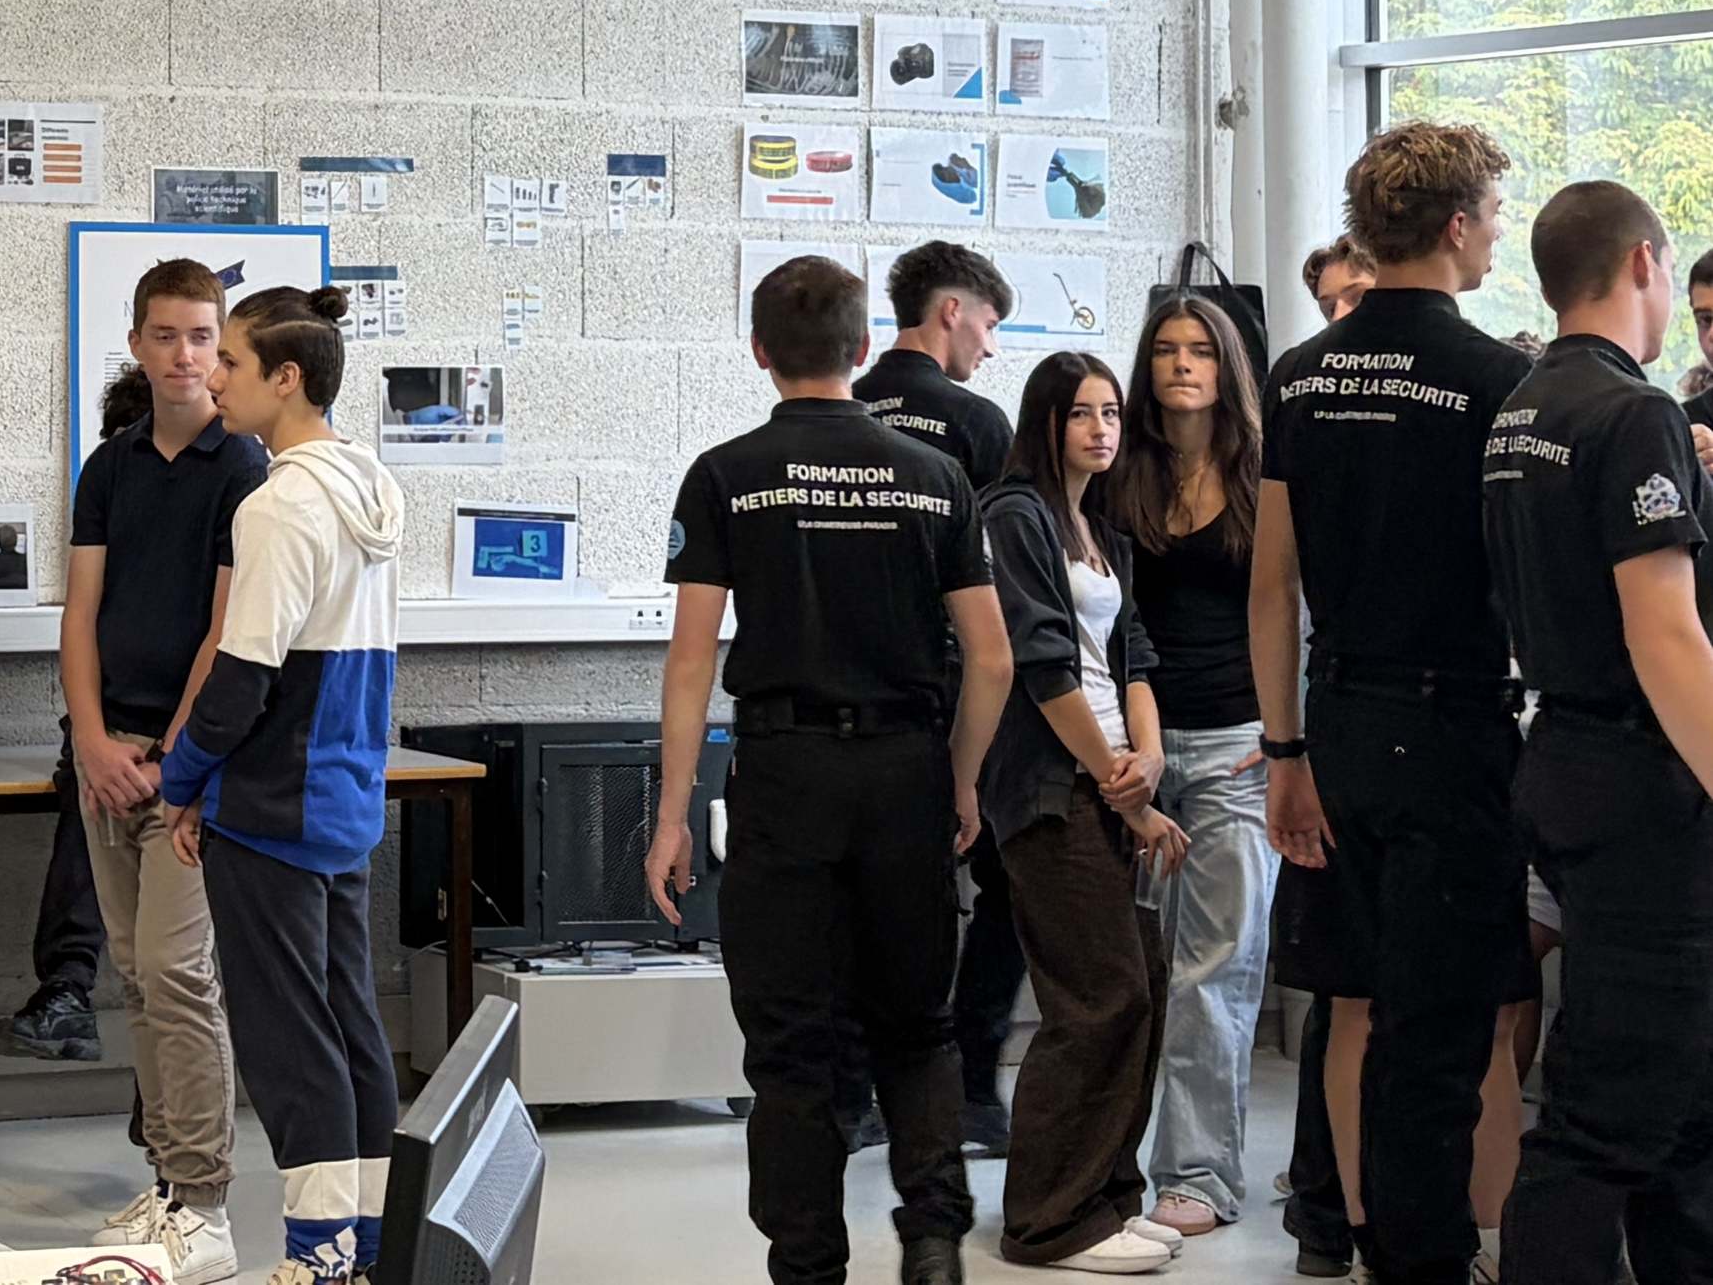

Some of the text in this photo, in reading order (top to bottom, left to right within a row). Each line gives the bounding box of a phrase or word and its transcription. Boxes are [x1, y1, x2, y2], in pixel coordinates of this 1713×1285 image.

[1320, 352, 1414, 371] FORMATION
[1339, 377, 1361, 395] DE
[1362, 378, 1379, 395] LA
[1380, 378, 1470, 412] SECURITE
[787, 463, 895, 484] FORMATION
[731, 487, 951, 516] METIERS DE LA SECURITE
[530, 534, 541, 553] 3
